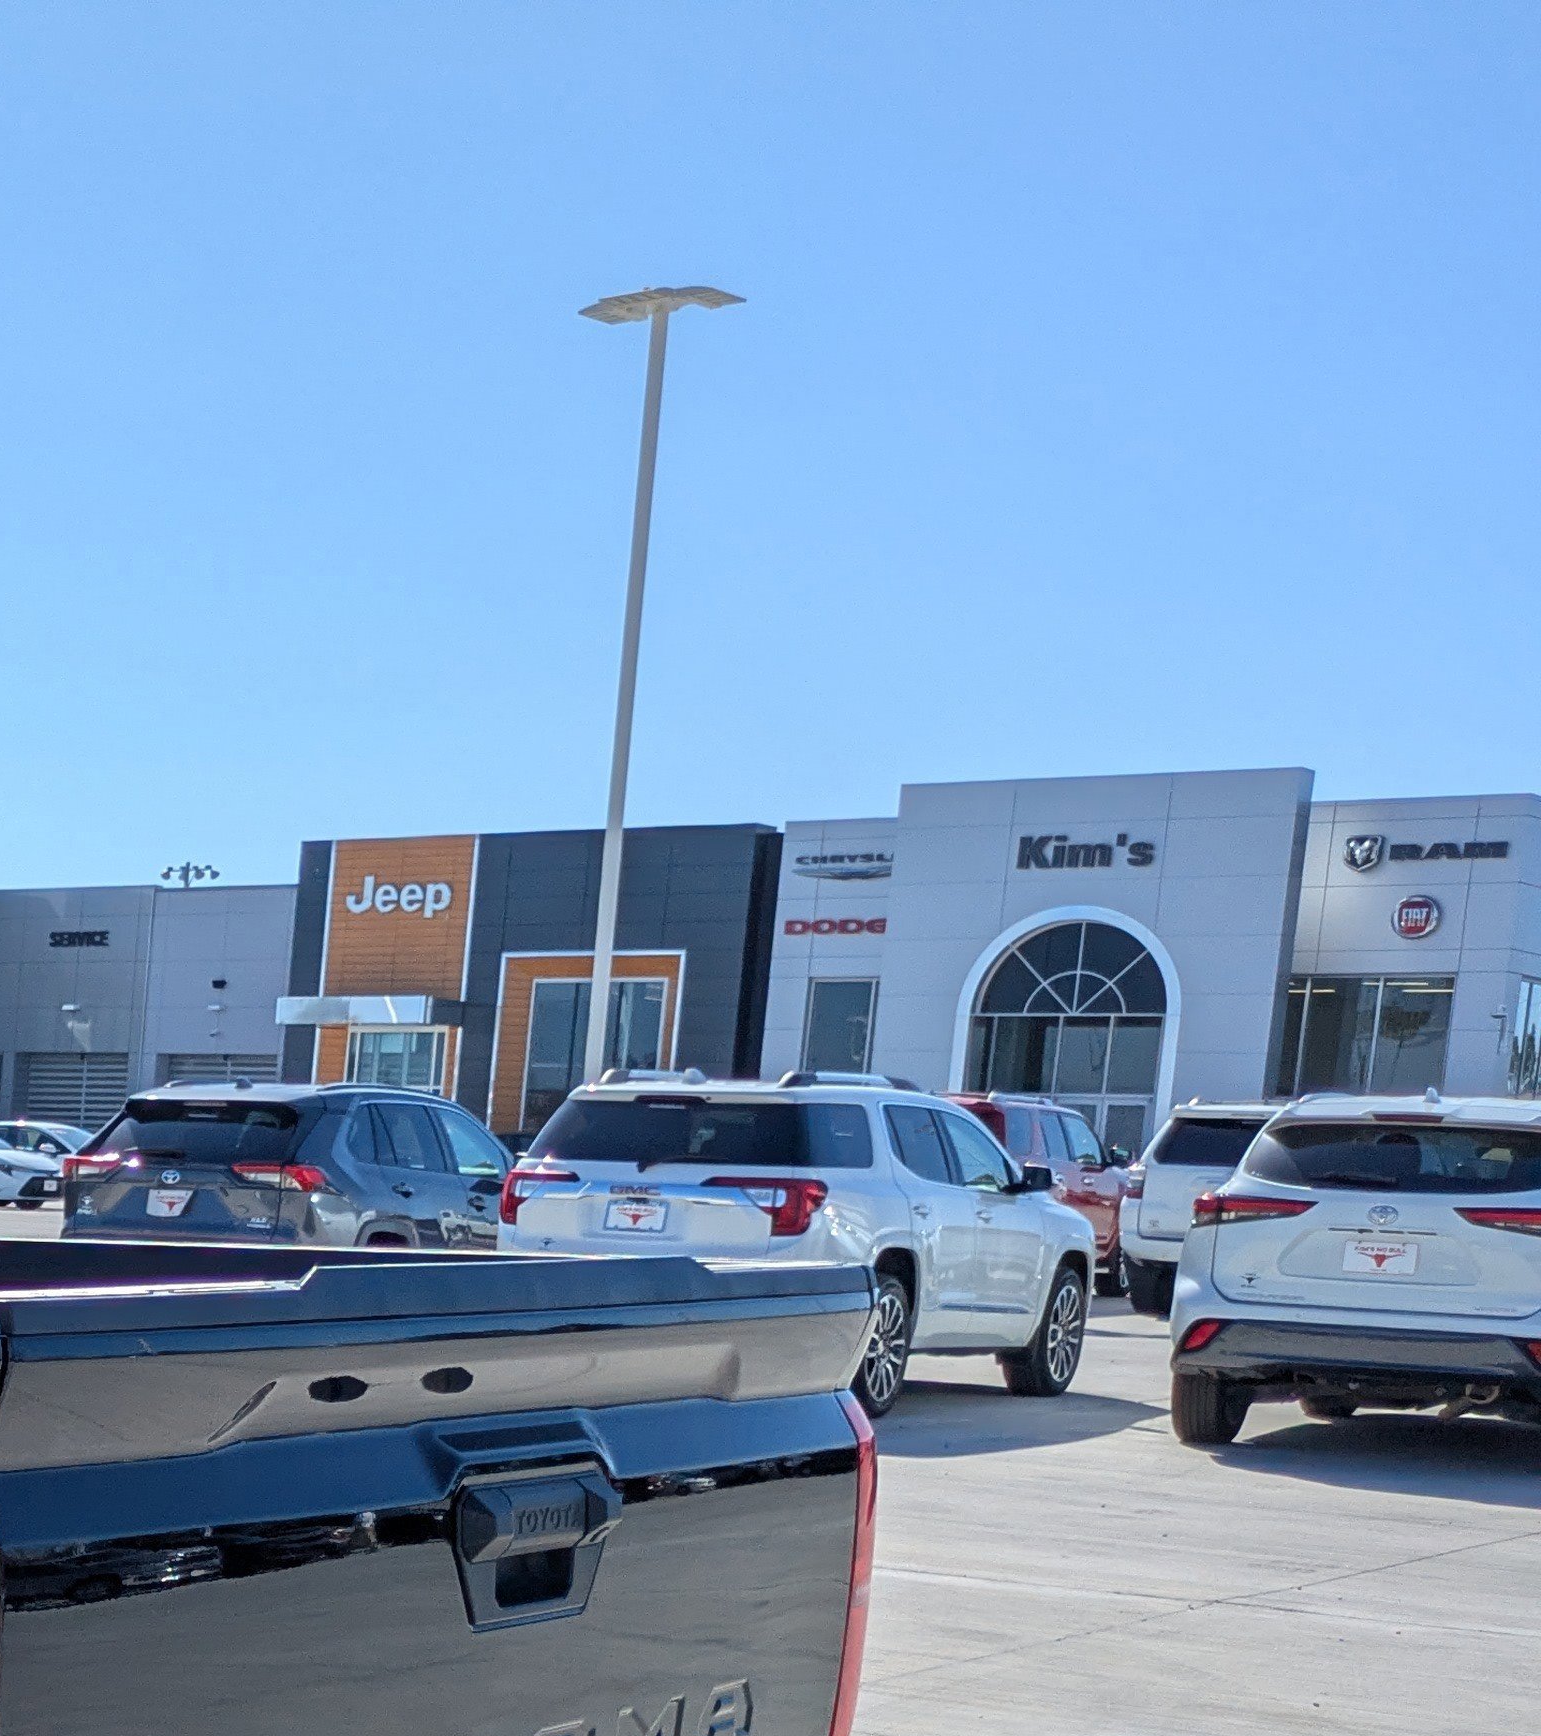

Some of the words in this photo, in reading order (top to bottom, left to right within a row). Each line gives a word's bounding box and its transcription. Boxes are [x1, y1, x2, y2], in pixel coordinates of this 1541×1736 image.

[795, 852, 894, 865] CHRYSL
[1017, 833, 1155, 869] Kim's
[1389, 841, 1509, 861] RAM
[346, 874, 452, 919] Jeep
[1401, 907, 1429, 927] FIAT
[48, 931, 110, 948] SERVICE
[517, 1502, 581, 1534] TOYOTA
